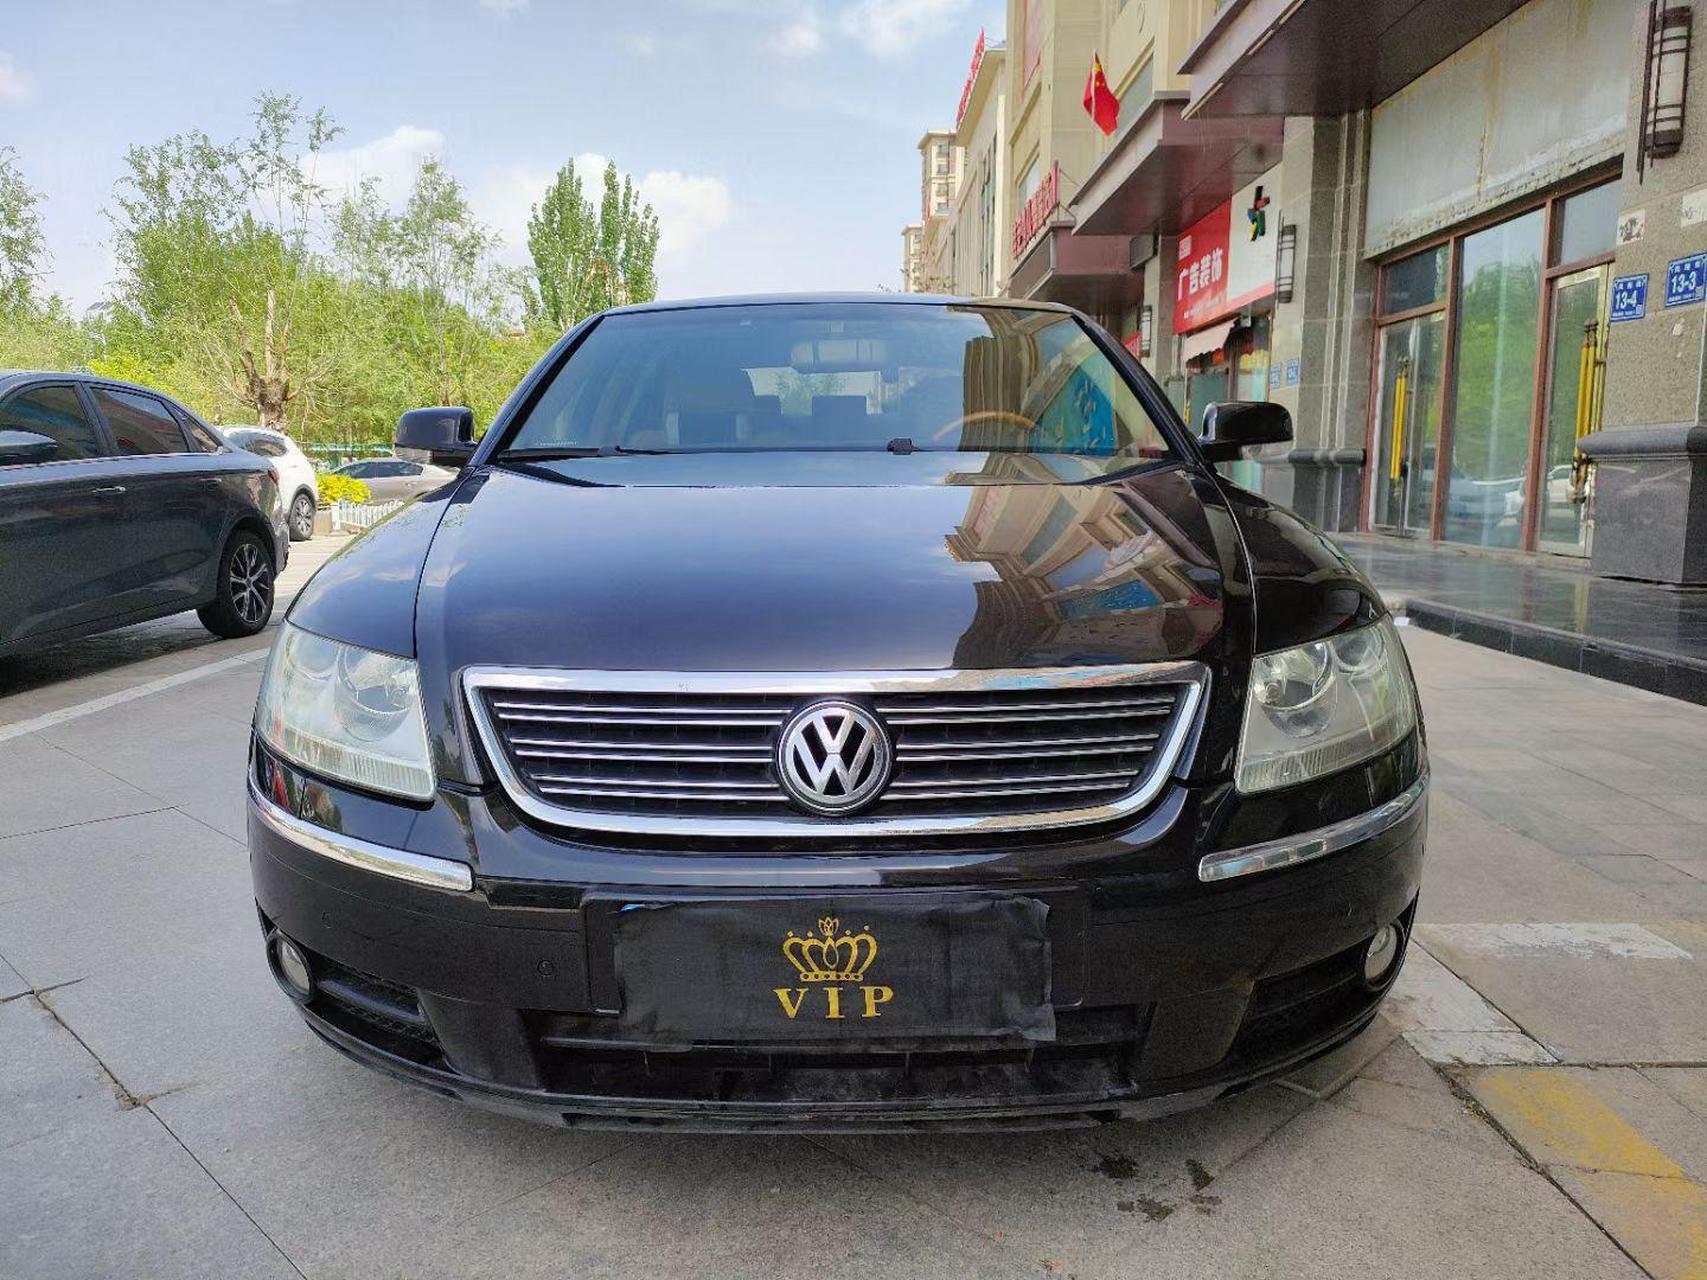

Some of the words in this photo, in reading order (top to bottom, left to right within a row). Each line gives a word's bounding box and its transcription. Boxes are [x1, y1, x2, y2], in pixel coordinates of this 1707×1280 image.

[1671, 271, 1697, 294] 13-3
[1615, 290, 1637, 310] 13-4
[773, 985, 894, 1020] VIP
